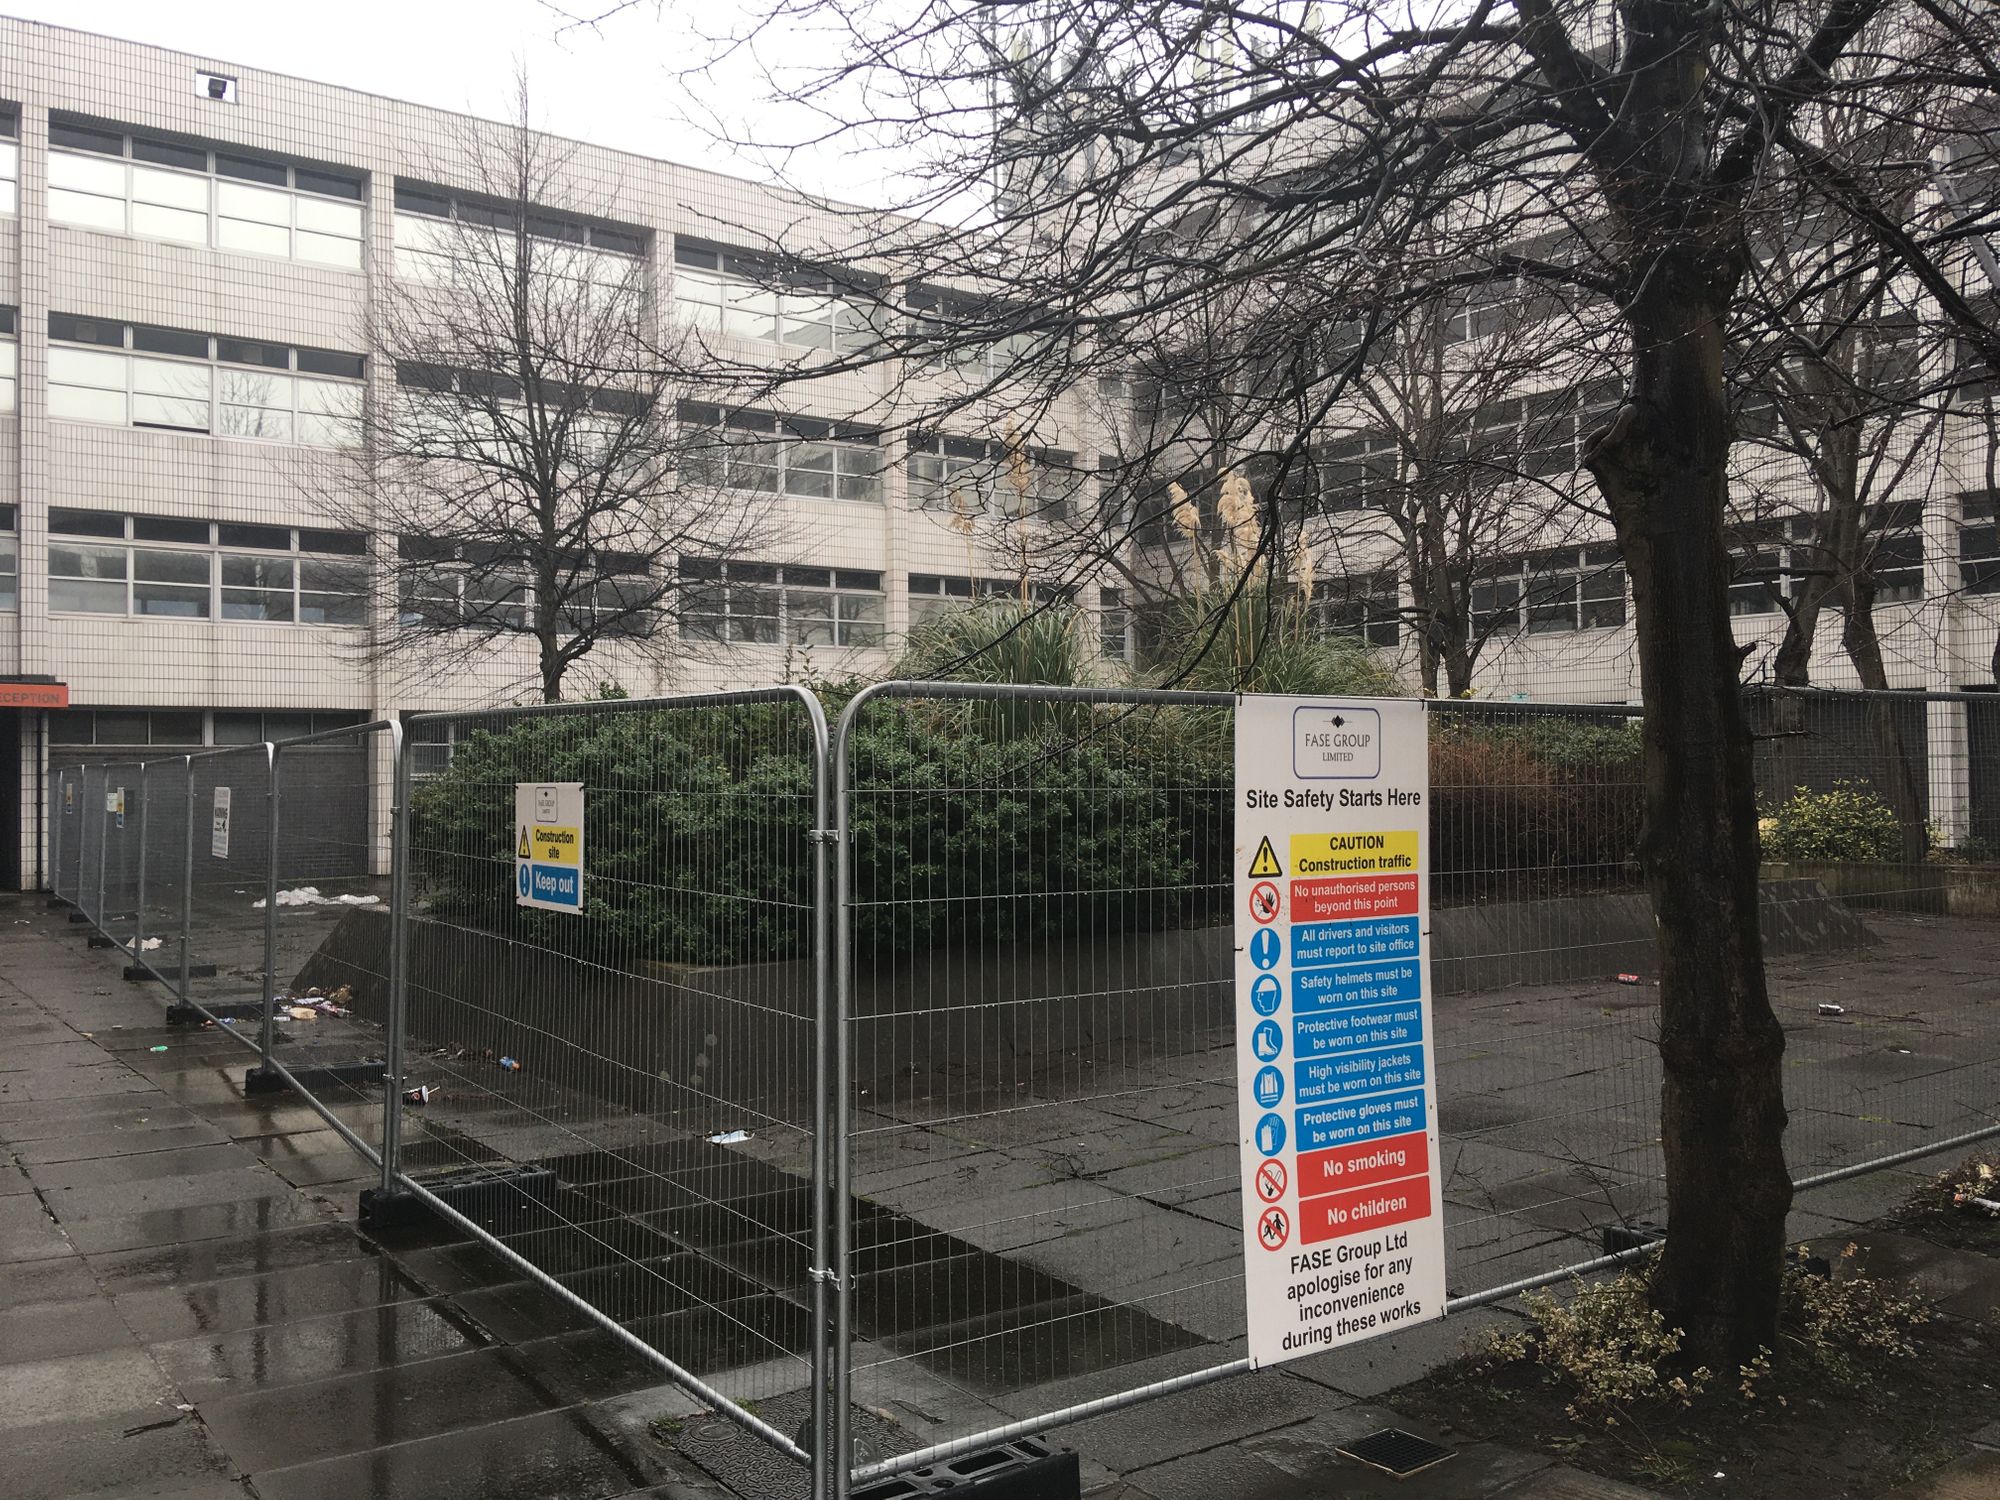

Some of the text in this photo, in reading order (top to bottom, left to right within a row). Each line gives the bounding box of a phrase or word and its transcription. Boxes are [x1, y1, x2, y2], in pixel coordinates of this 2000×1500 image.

[1305, 733, 1371, 748] FASE GROUP
[1322, 752, 1354, 762] LIMITED
[1246, 788, 1421, 812] Site Safety Starts Here
[535, 829, 574, 844] Construction
[1330, 835, 1384, 851] CAUTION
[548, 846, 560, 859] site
[1299, 854, 1412, 872] Construction traffic
[535, 871, 574, 896] Keep out
[1294, 881, 1416, 897] No unauthorised persons
[1314, 896, 1398, 915] beyond this point
[1302, 923, 1410, 942] All drivers and visitors
[1297, 939, 1414, 960] must report to site office
[1300, 967, 1413, 989] Safety helmets must be
[1318, 985, 1398, 1004] worn on this site
[1297, 1008, 1418, 1034] Protective footwear must
[1313, 1027, 1408, 1050] be worn on this site
[1308, 1054, 1411, 1080] High visibility jackets
[1299, 1068, 1421, 1097] must be worn on this site
[1303, 1095, 1419, 1126] Protective gloves must
[1312, 1116, 1412, 1143] be worn on this site
[1323, 1149, 1406, 1178] No smoking
[1327, 1196, 1407, 1225] No children
[1290, 1230, 1408, 1274] FASE Group Ltd
[1287, 1256, 1413, 1301] apologise for any
[1299, 1282, 1405, 1321] inconvenience
[1282, 1300, 1421, 1351] during these works
